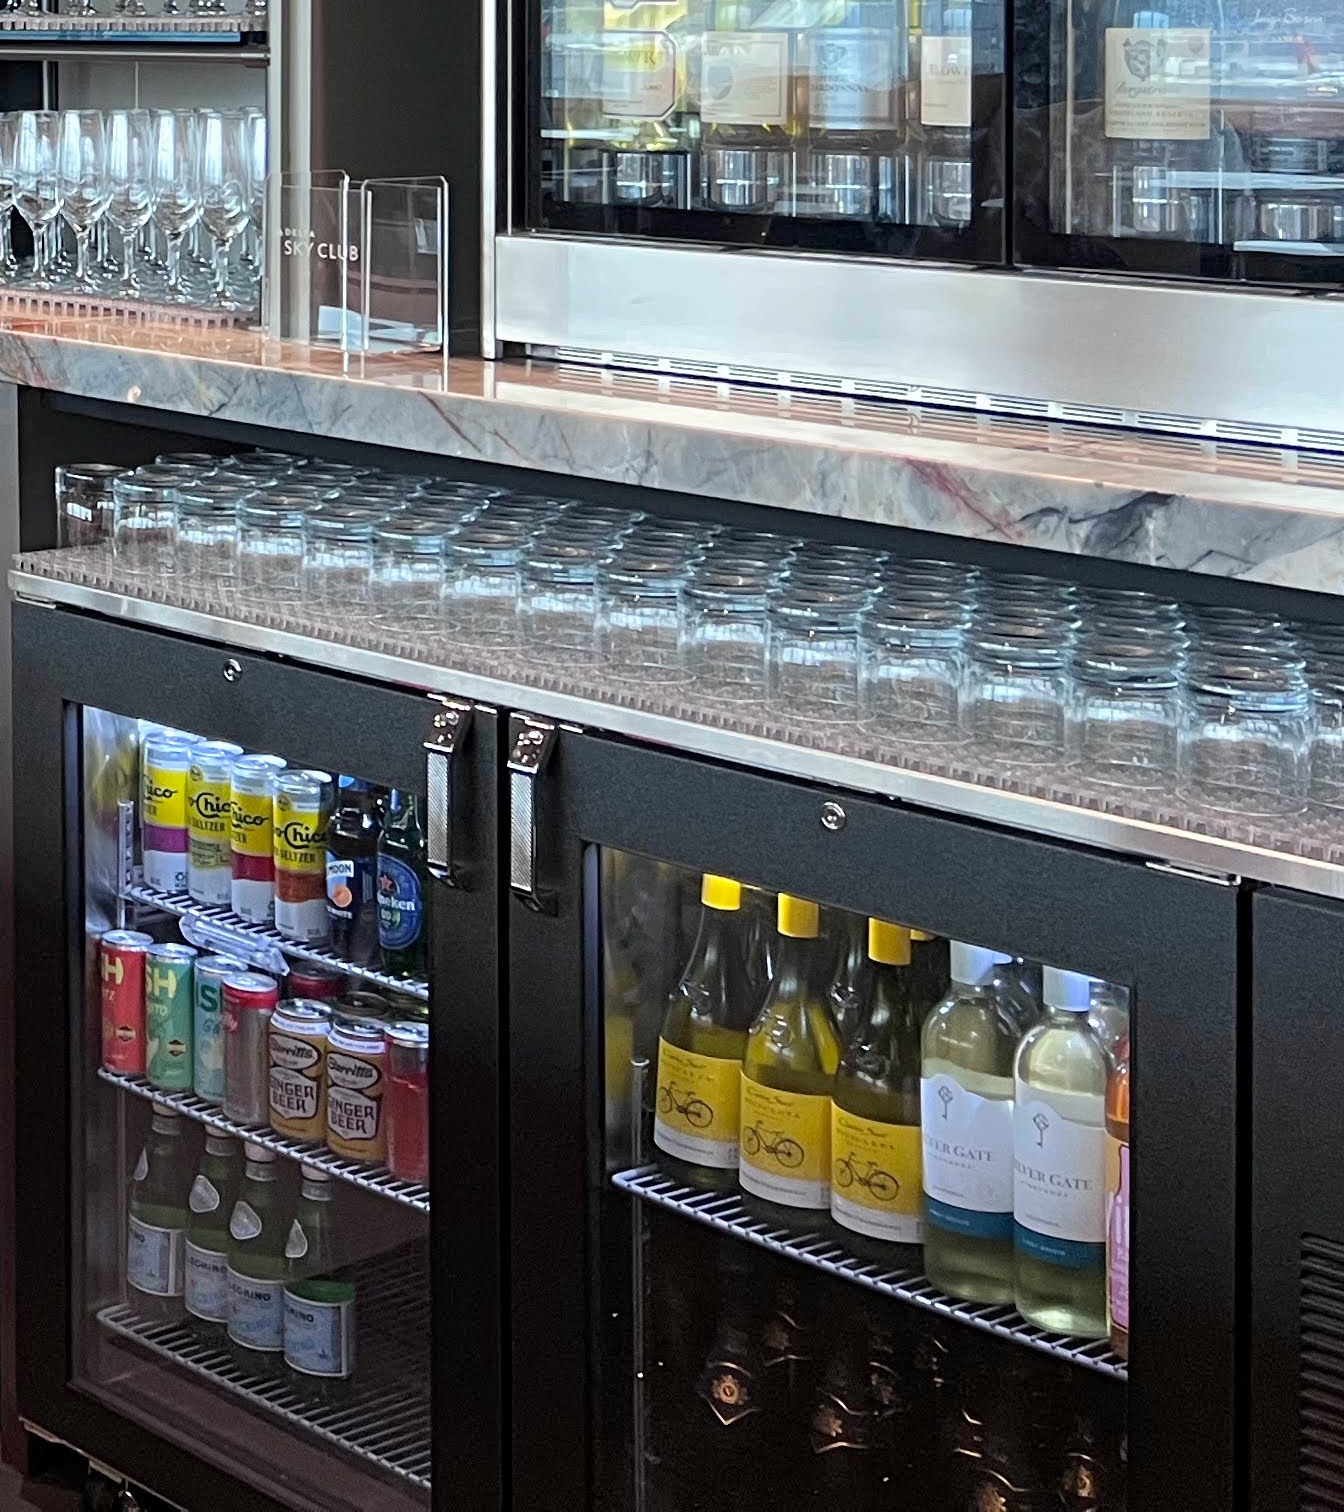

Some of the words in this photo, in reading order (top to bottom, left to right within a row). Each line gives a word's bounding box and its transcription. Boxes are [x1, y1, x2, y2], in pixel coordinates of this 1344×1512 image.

[284, 239, 315, 256] SKY
[317, 242, 359, 262] CLUB
[196, 792, 231, 819] Chic
[272, 1090, 307, 1114] BEER
[331, 1112, 368, 1135] BEER
